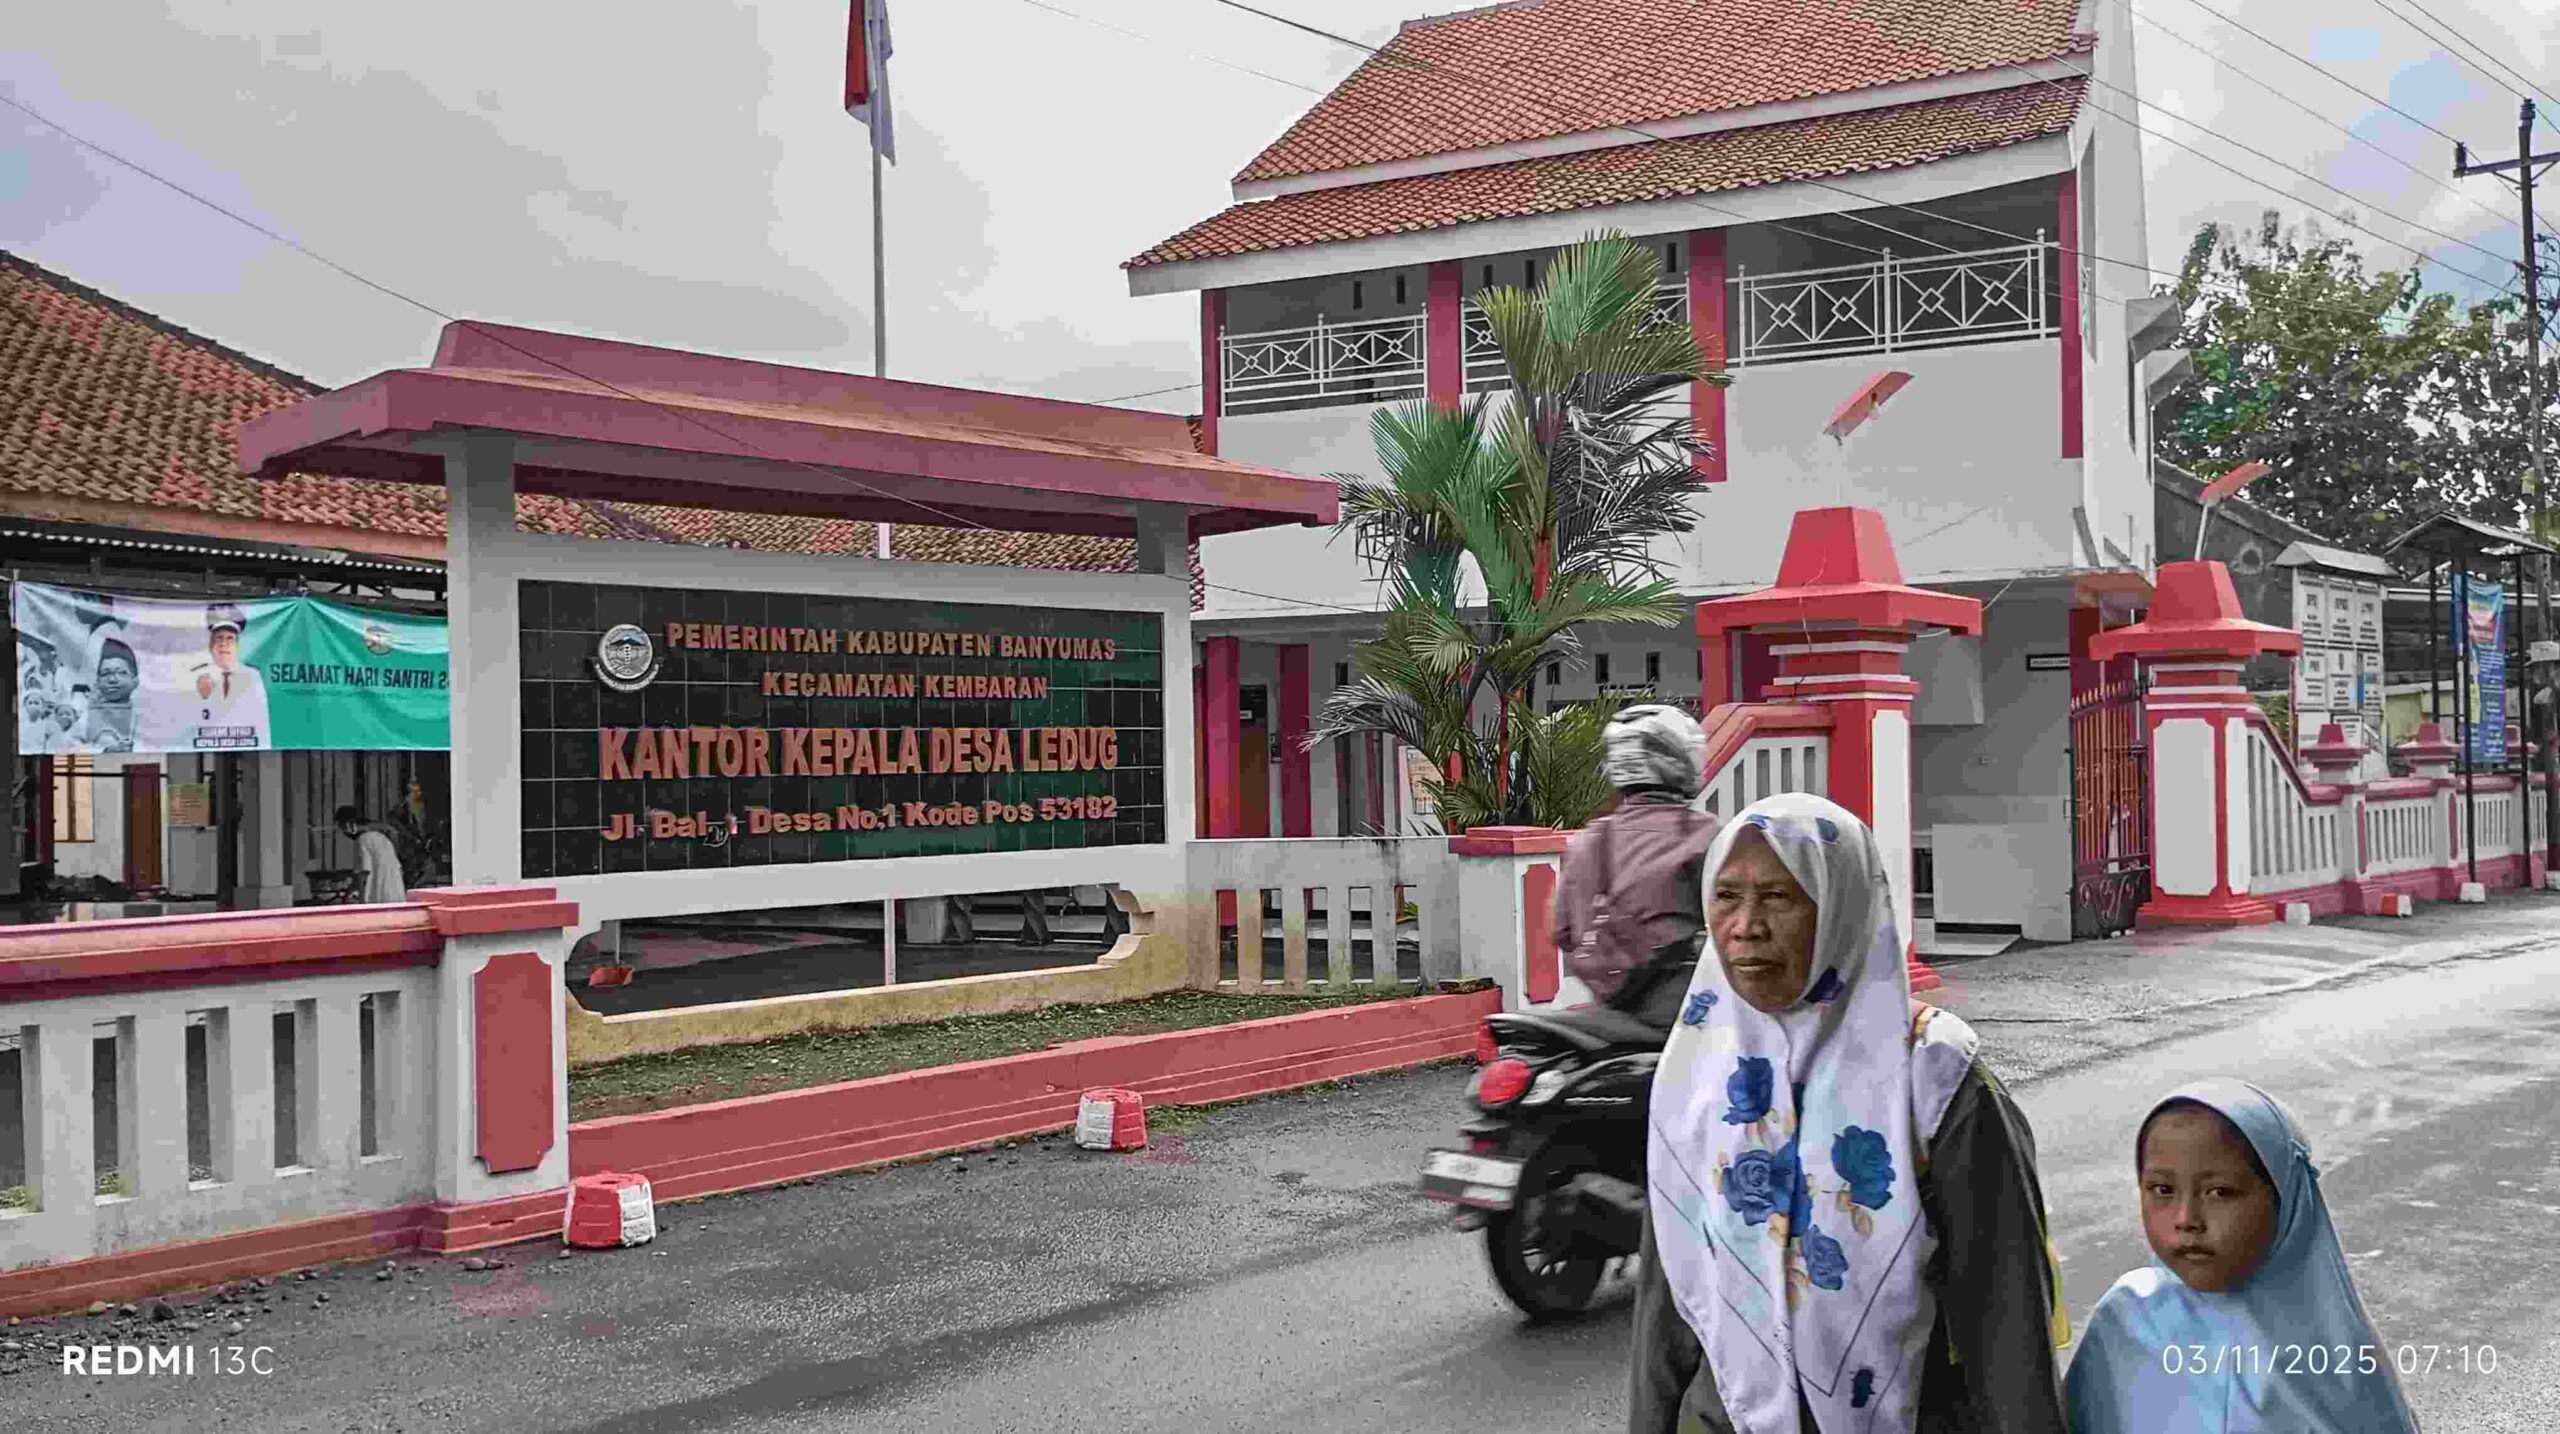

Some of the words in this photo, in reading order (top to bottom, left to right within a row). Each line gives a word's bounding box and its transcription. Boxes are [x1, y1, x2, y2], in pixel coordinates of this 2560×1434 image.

[668, 623, 837, 653] PEMERINTAH
[847, 630, 991, 656] KABUPATEN
[1001, 635, 1116, 660] BANYUMAS
[270, 663, 341, 684] SELAMAT
[344, 667, 378, 687] HARI
[383, 669, 433, 689] SANTRI
[438, 671, 450, 690] 2
[762, 671, 915, 698] KECAMATAN
[924, 675, 1047, 699] KEMBARAN
[602, 728, 770, 779] KANTOR
[783, 726, 922, 776] KEPALA
[929, 726, 1014, 774] DESA
[1021, 726, 1118, 772] LEDUG
[602, 812, 645, 841] Jl.
[748, 804, 832, 835] Desa
[902, 801, 979, 828] Kode
[982, 799, 1035, 823] Pos
[1038, 795, 1119, 820] 53182
